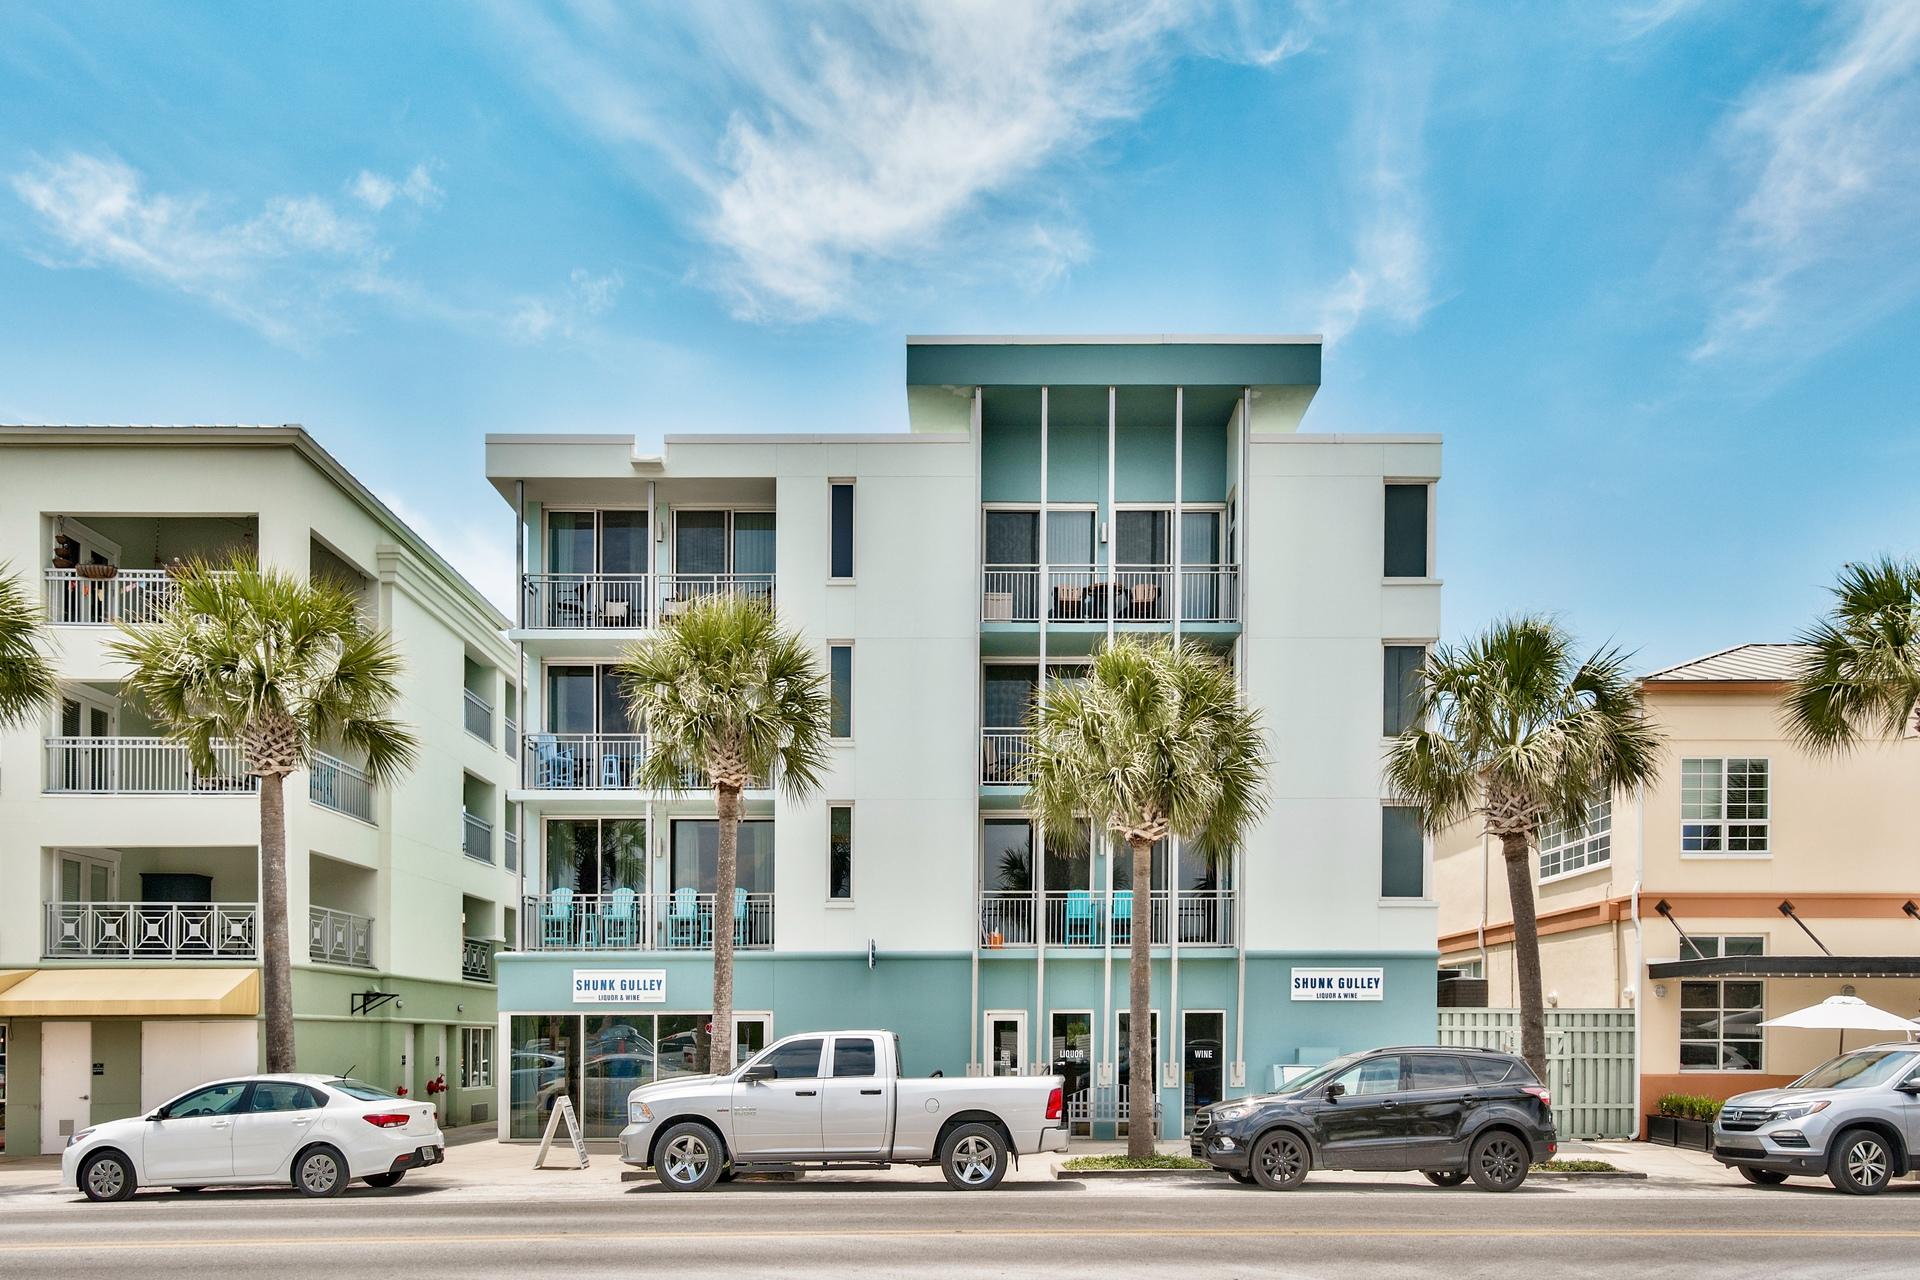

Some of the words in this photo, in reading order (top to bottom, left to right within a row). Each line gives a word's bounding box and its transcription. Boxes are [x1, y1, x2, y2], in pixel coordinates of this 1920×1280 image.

[576, 979, 615, 991] SHUNK
[620, 979, 662, 991] GULLEY
[1294, 977, 1333, 989] SHUNK
[1338, 977, 1380, 989] GULLEY
[1059, 1049, 1084, 1058] LIQUOR
[1194, 1049, 1213, 1059] WINE
